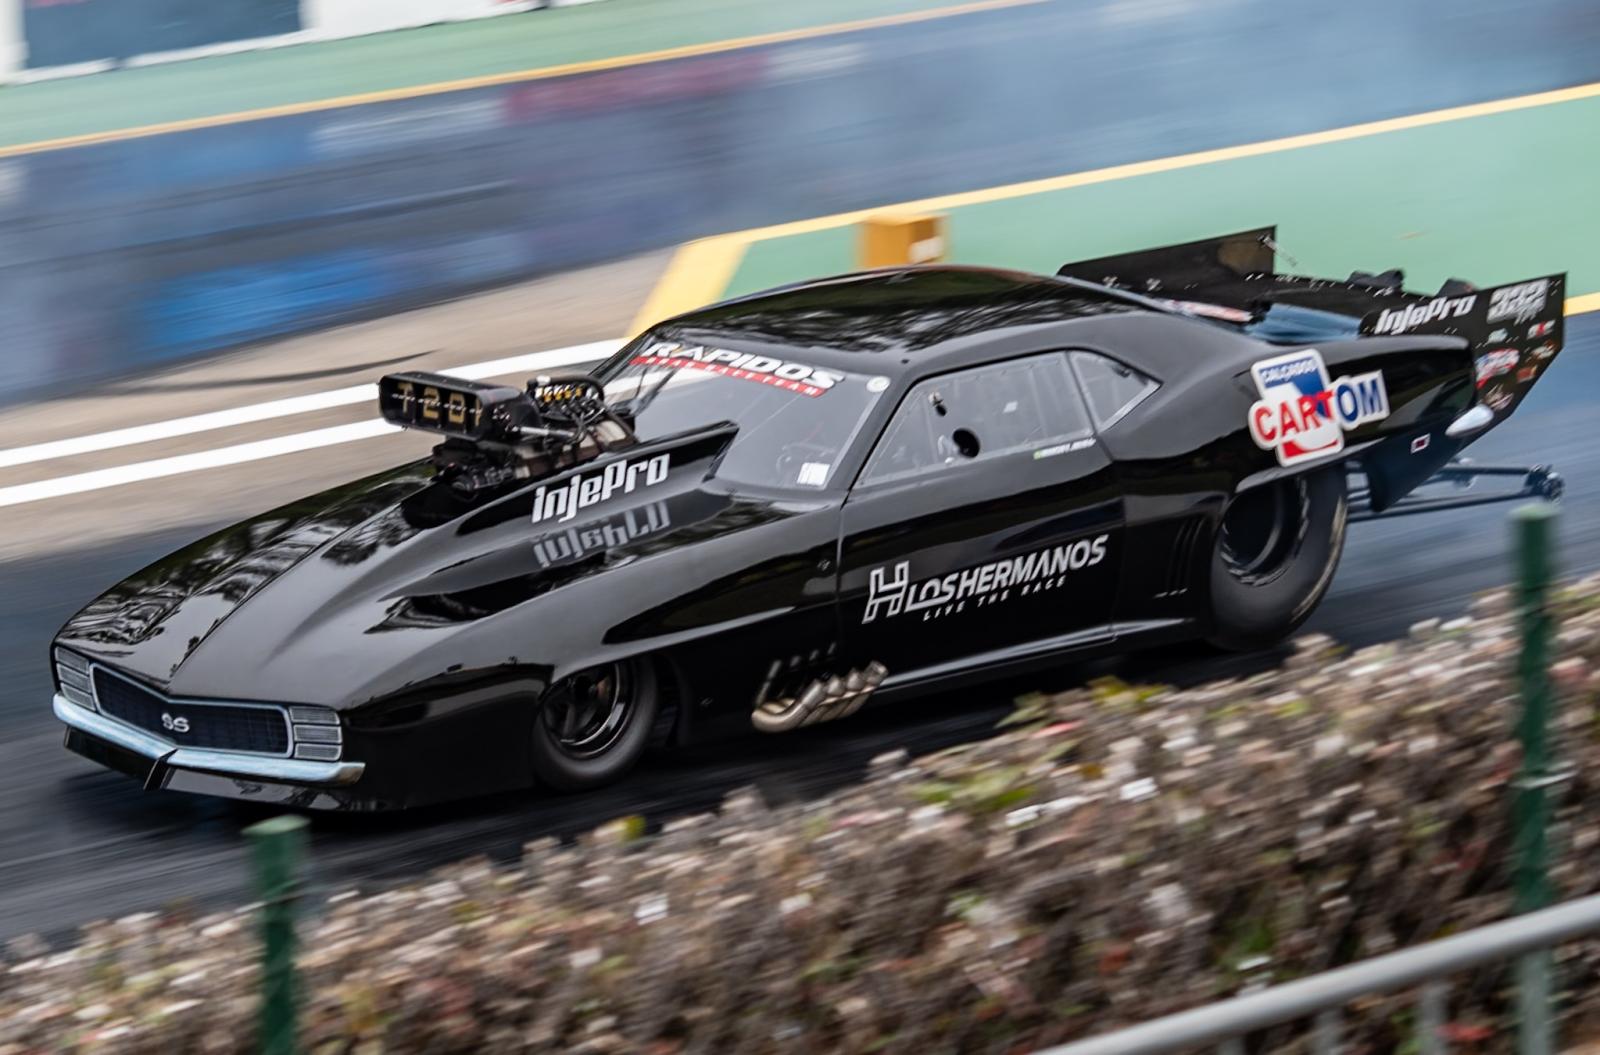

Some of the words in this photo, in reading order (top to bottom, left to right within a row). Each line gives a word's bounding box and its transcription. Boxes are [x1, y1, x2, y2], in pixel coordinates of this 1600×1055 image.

[641, 342, 845, 389] RAPIDOS
[1255, 377, 1383, 441] CARTOM
[923, 601, 965, 621] LIVE
[977, 590, 1010, 608] THE
[1020, 575, 1066, 596] RACE
